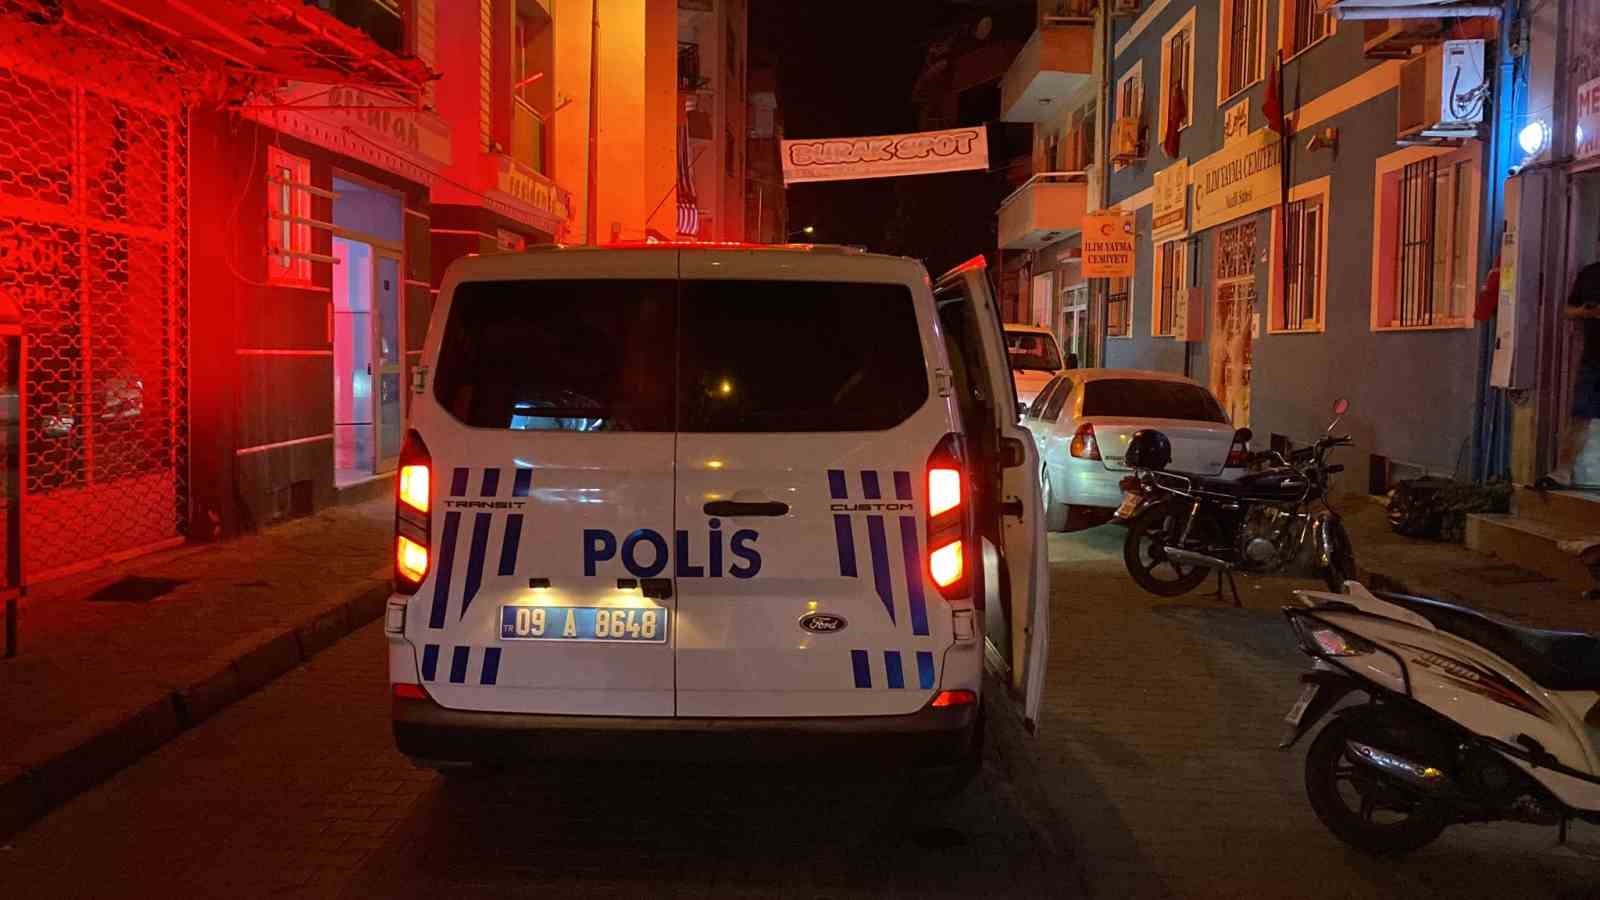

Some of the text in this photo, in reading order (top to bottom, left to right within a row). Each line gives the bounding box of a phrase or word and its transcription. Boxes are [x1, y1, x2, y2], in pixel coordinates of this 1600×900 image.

[790, 131, 978, 166] BURAK SPOT
[1105, 240, 1132, 251] YAYMA
[443, 500, 526, 509] TRANSIT
[830, 503, 913, 512] CUSTOM
[583, 518, 762, 579] POLİS
[503, 608, 656, 638] TR 09 A 8648
